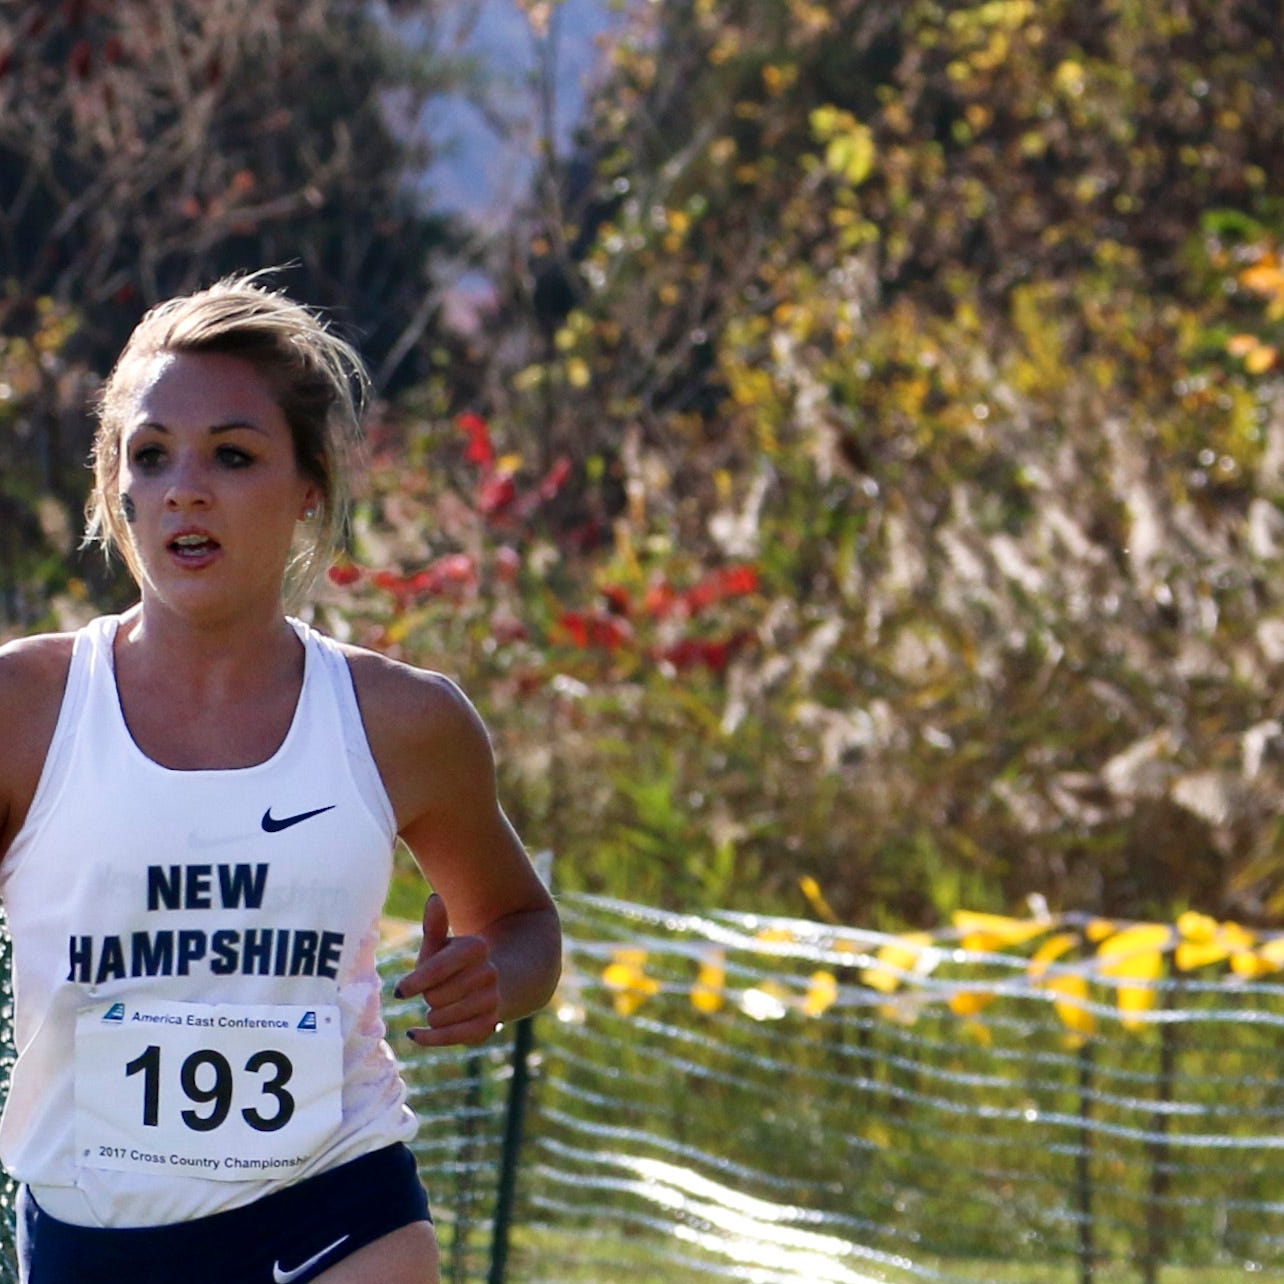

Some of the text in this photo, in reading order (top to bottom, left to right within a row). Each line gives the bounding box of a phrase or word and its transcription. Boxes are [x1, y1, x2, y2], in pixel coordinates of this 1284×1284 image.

[147, 863, 270, 911] NEW
[67, 929, 345, 984] HAMPSHIRE
[132, 1011, 289, 1029] America East Conference
[125, 1045, 295, 1132] 193
[99, 1145, 127, 1159] 2017
[130, 1150, 166, 1166] Cross
[169, 1155, 220, 1170] Country
